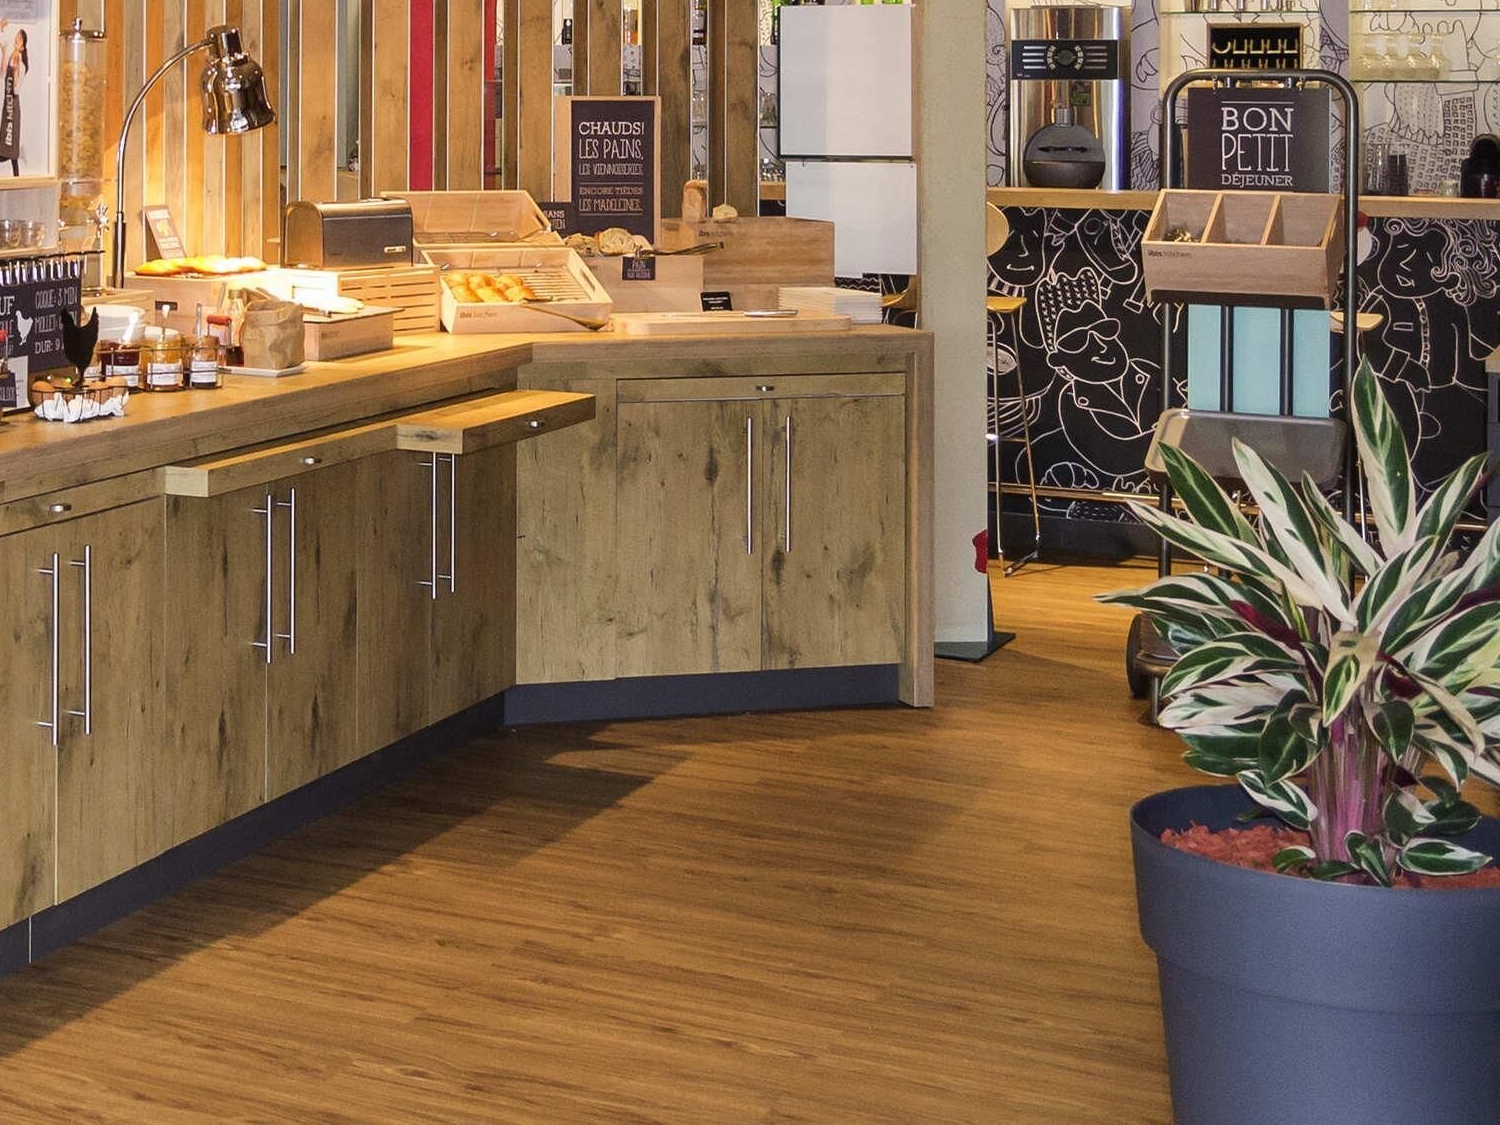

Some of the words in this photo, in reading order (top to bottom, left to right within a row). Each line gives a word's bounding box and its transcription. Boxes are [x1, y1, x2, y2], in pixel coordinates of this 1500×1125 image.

[1220, 107, 1294, 132] BON
[579, 138, 599, 159] LES
[1221, 133, 1294, 172] PETIT
[1221, 172, 1294, 188] DÉJEUNER
[579, 198, 592, 212] LES
